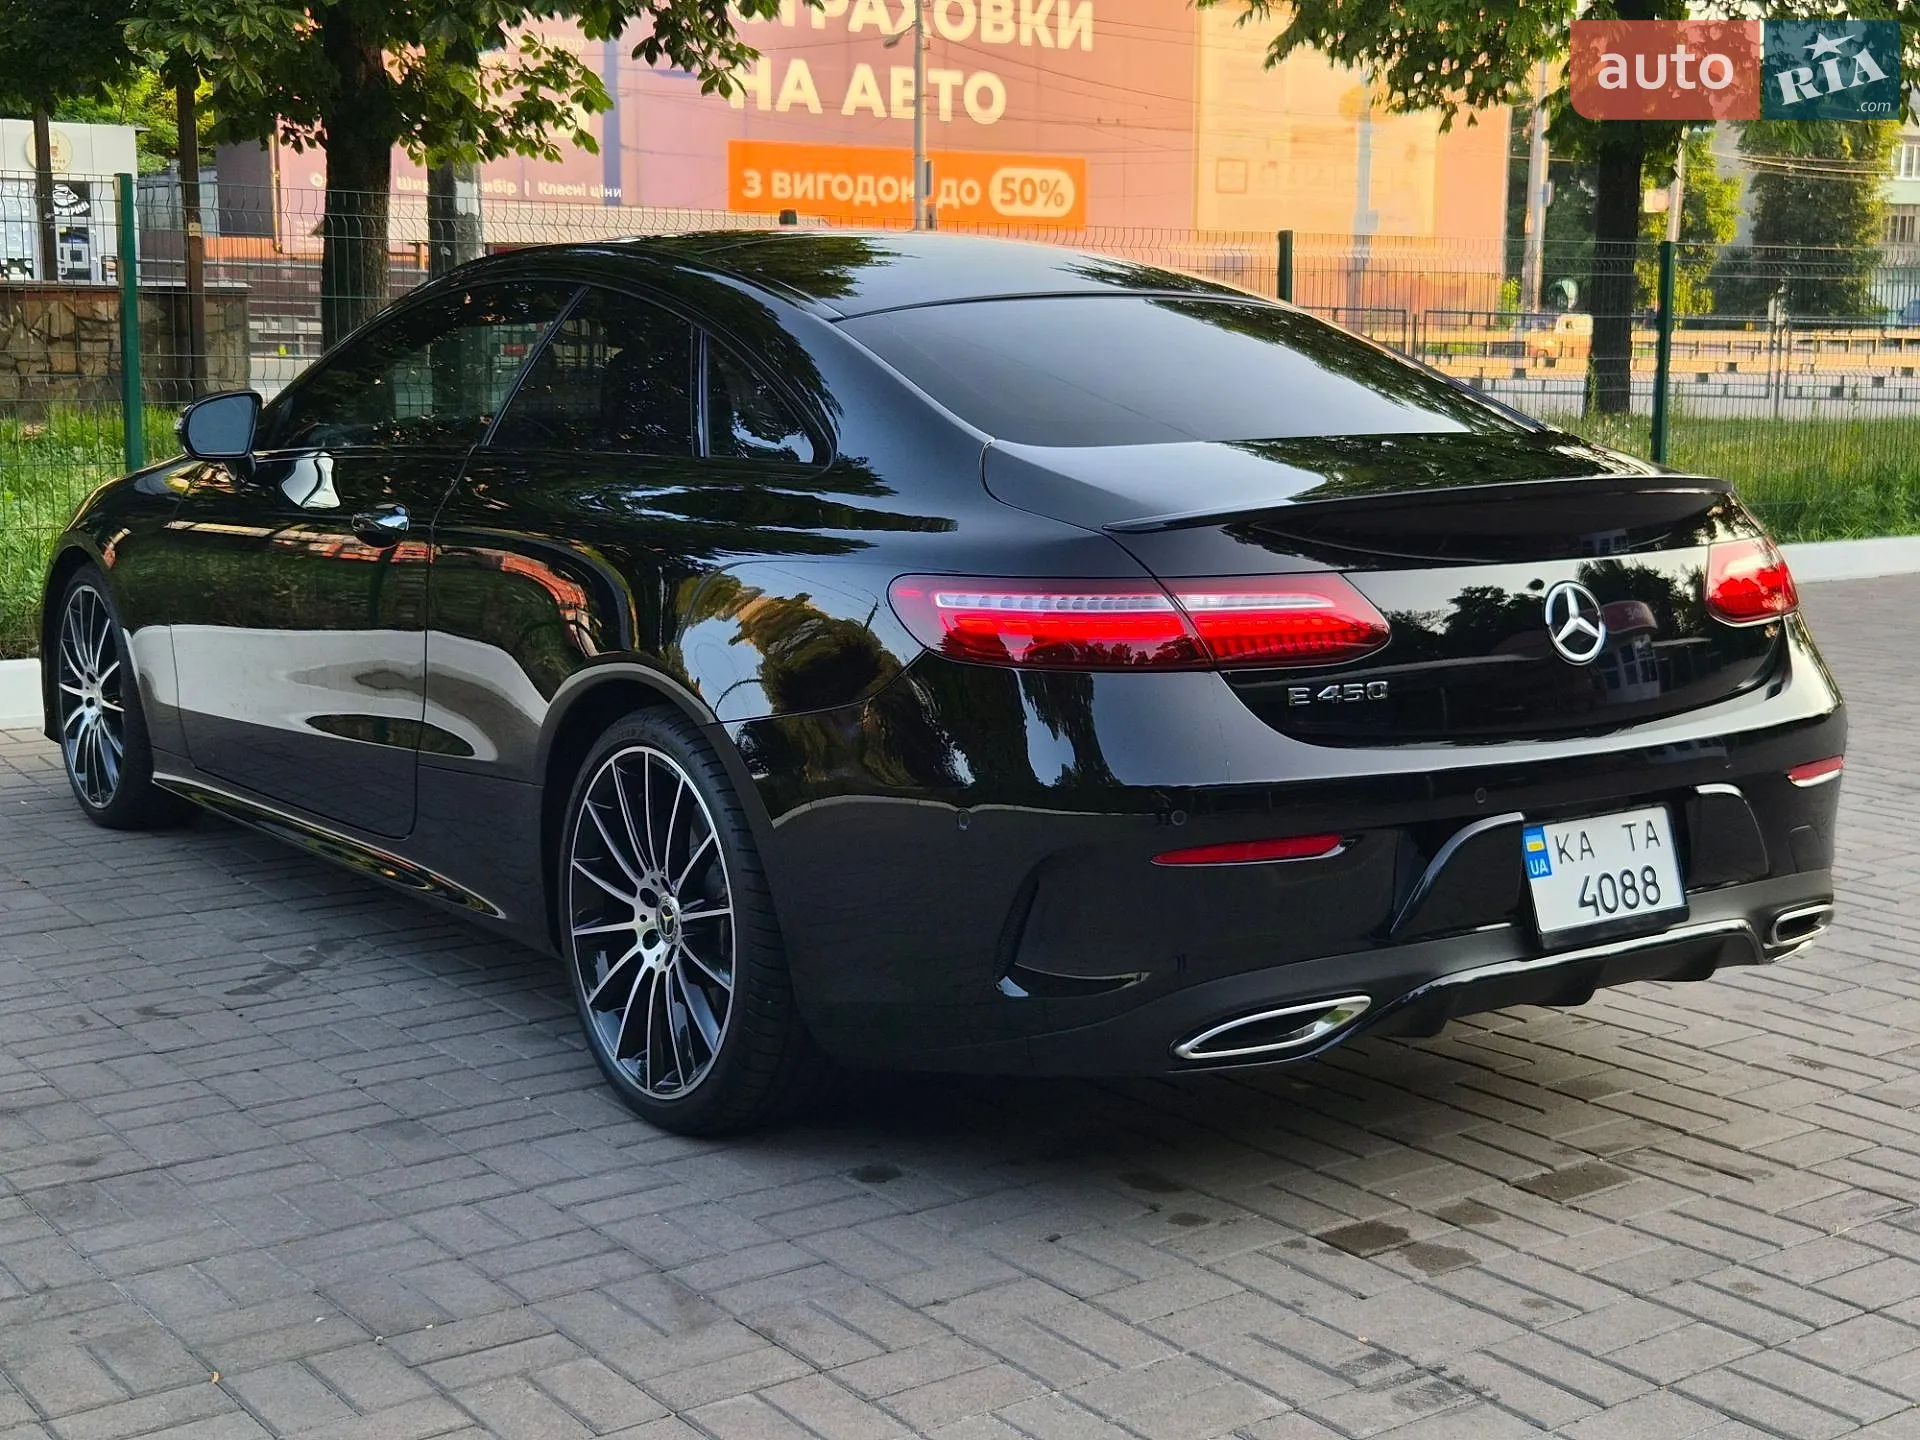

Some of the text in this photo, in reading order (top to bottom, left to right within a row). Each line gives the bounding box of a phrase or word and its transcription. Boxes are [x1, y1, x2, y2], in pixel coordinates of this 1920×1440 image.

[728, 57, 1007, 125] НА АВТО
[481, 178, 622, 199] ибір Класні ціни
[936, 178, 981, 209] ДО
[1000, 177, 1064, 208] 50%
[1288, 681, 1389, 706] E 450
[1555, 820, 1661, 864] KA TA
[1529, 857, 1549, 876] UA
[1578, 865, 1661, 917] 4088
